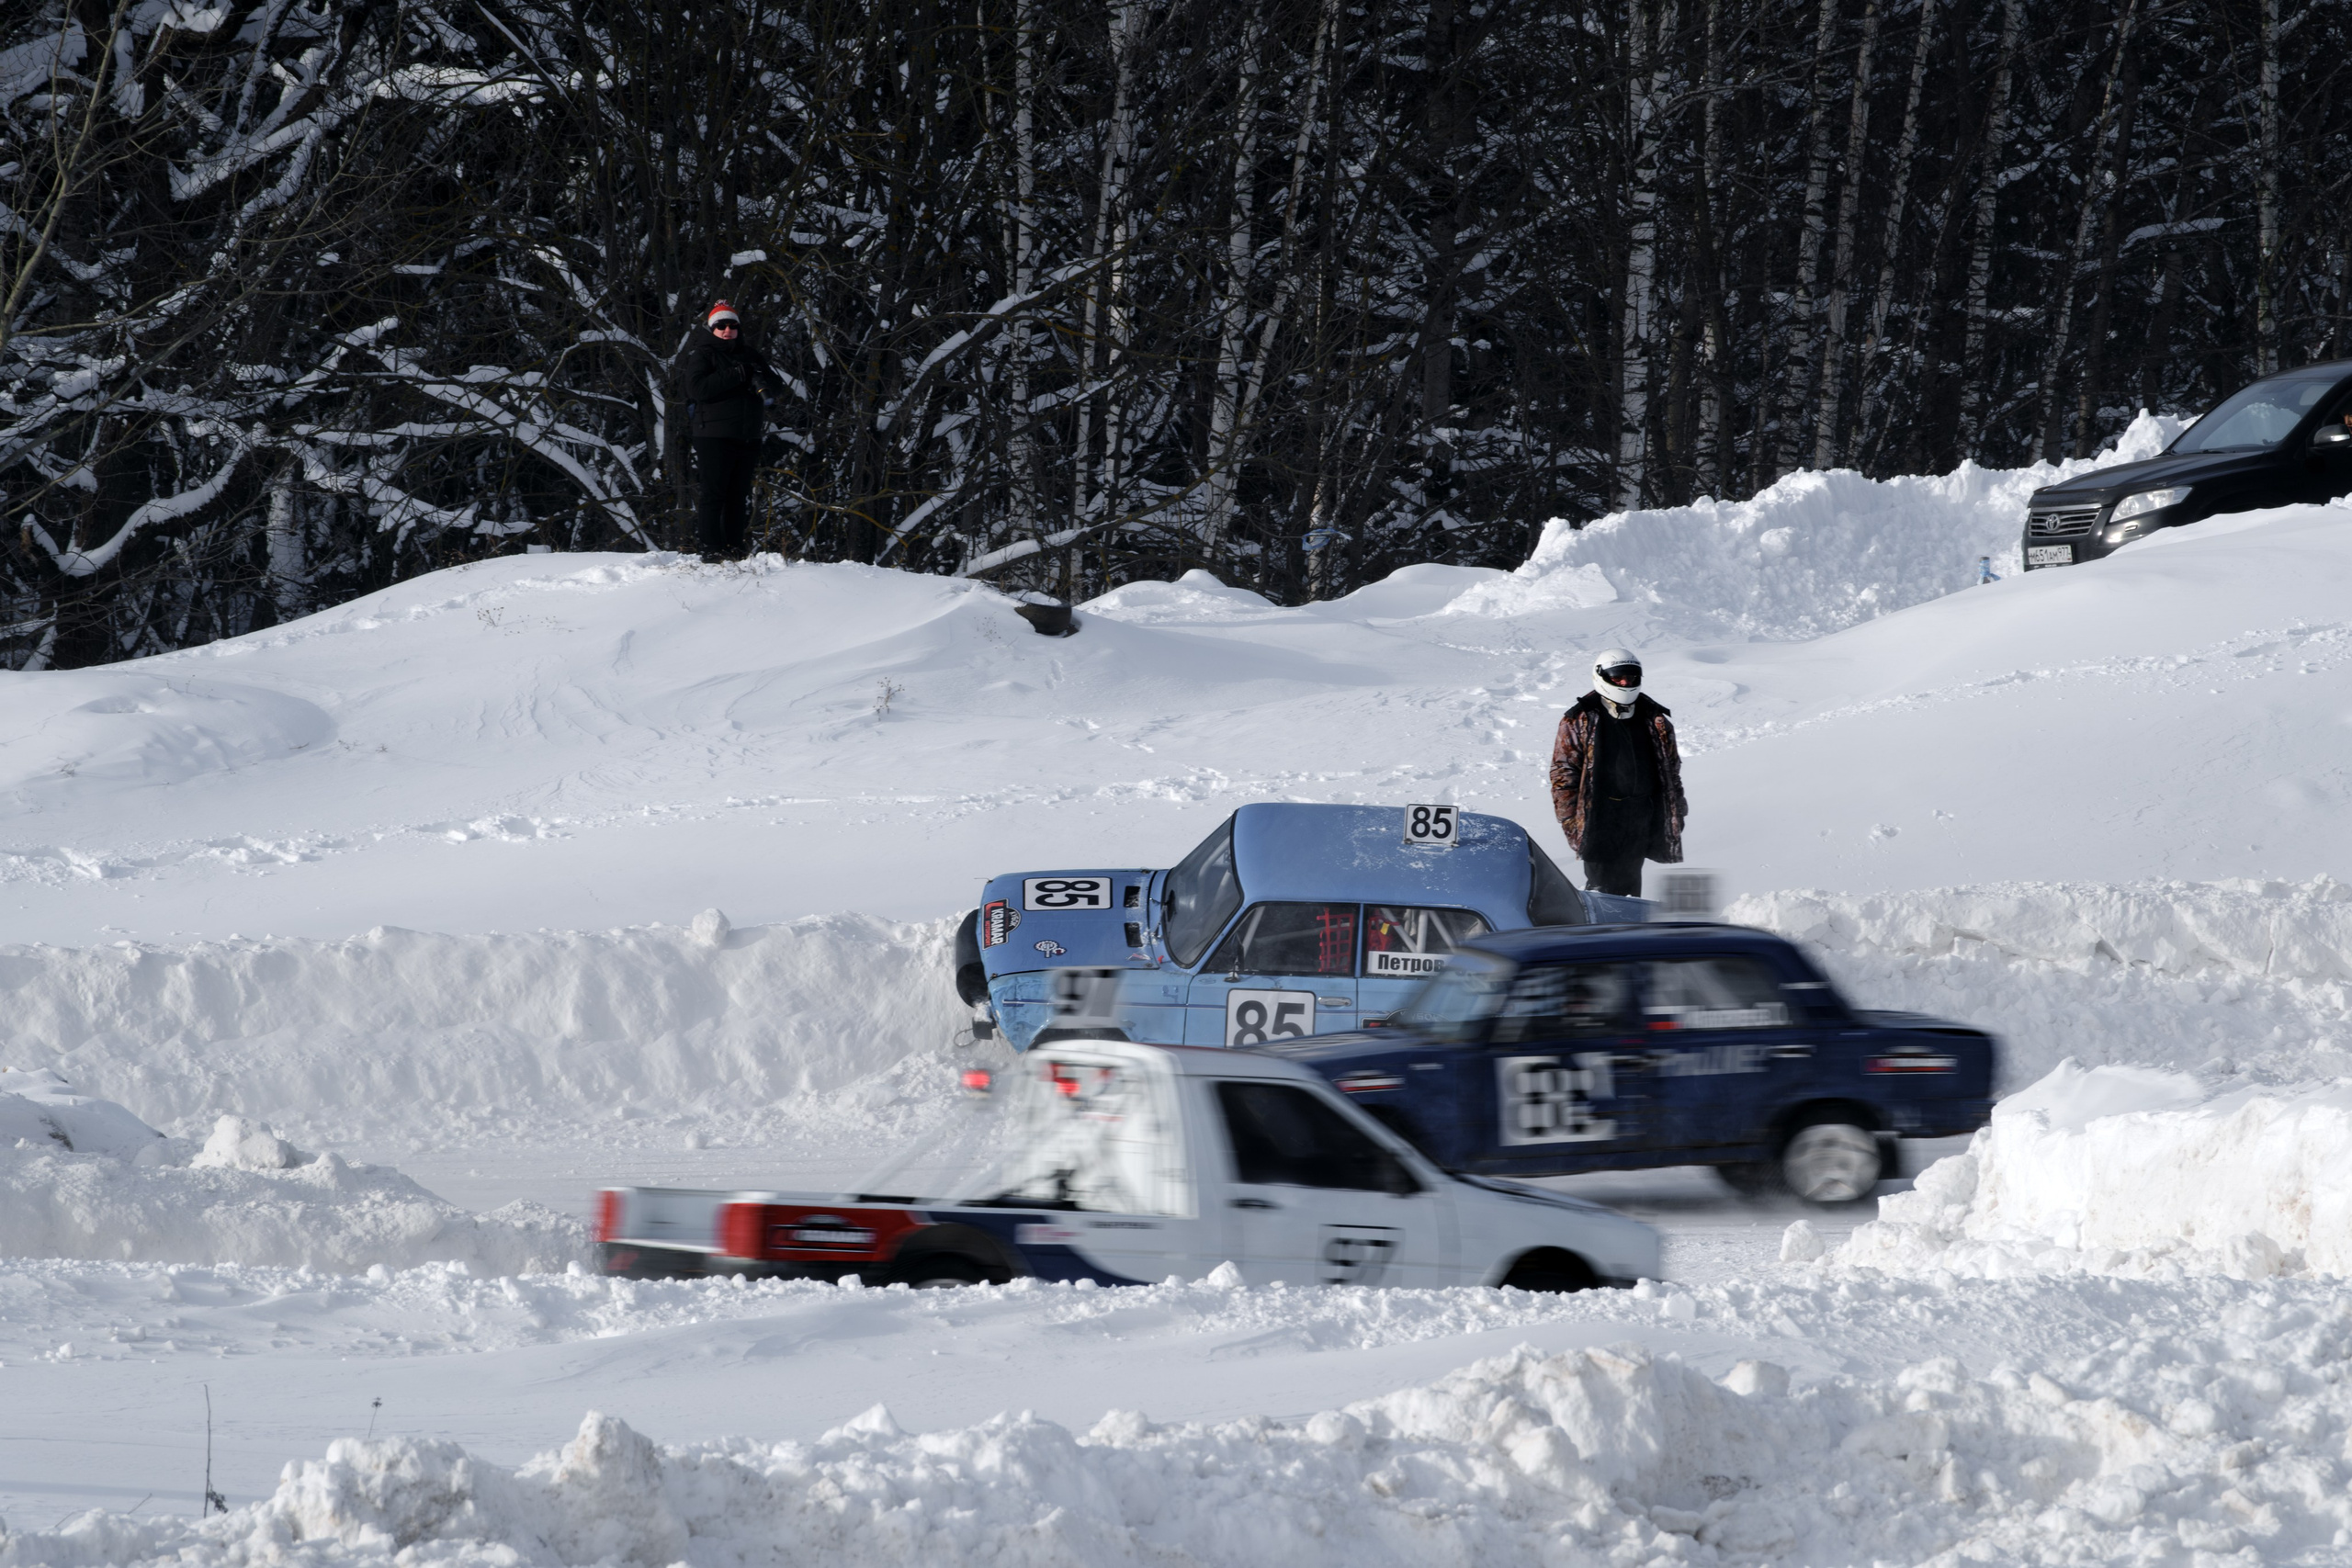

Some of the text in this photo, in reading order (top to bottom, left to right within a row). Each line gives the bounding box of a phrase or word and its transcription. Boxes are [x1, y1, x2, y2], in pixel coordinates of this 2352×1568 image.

[1411, 807, 1452, 839] 85
[1035, 880, 1100, 907] 85
[991, 908, 1004, 945] KRAMAR
[1377, 953, 1445, 973] Петров
[1233, 999, 1305, 1048] 85
